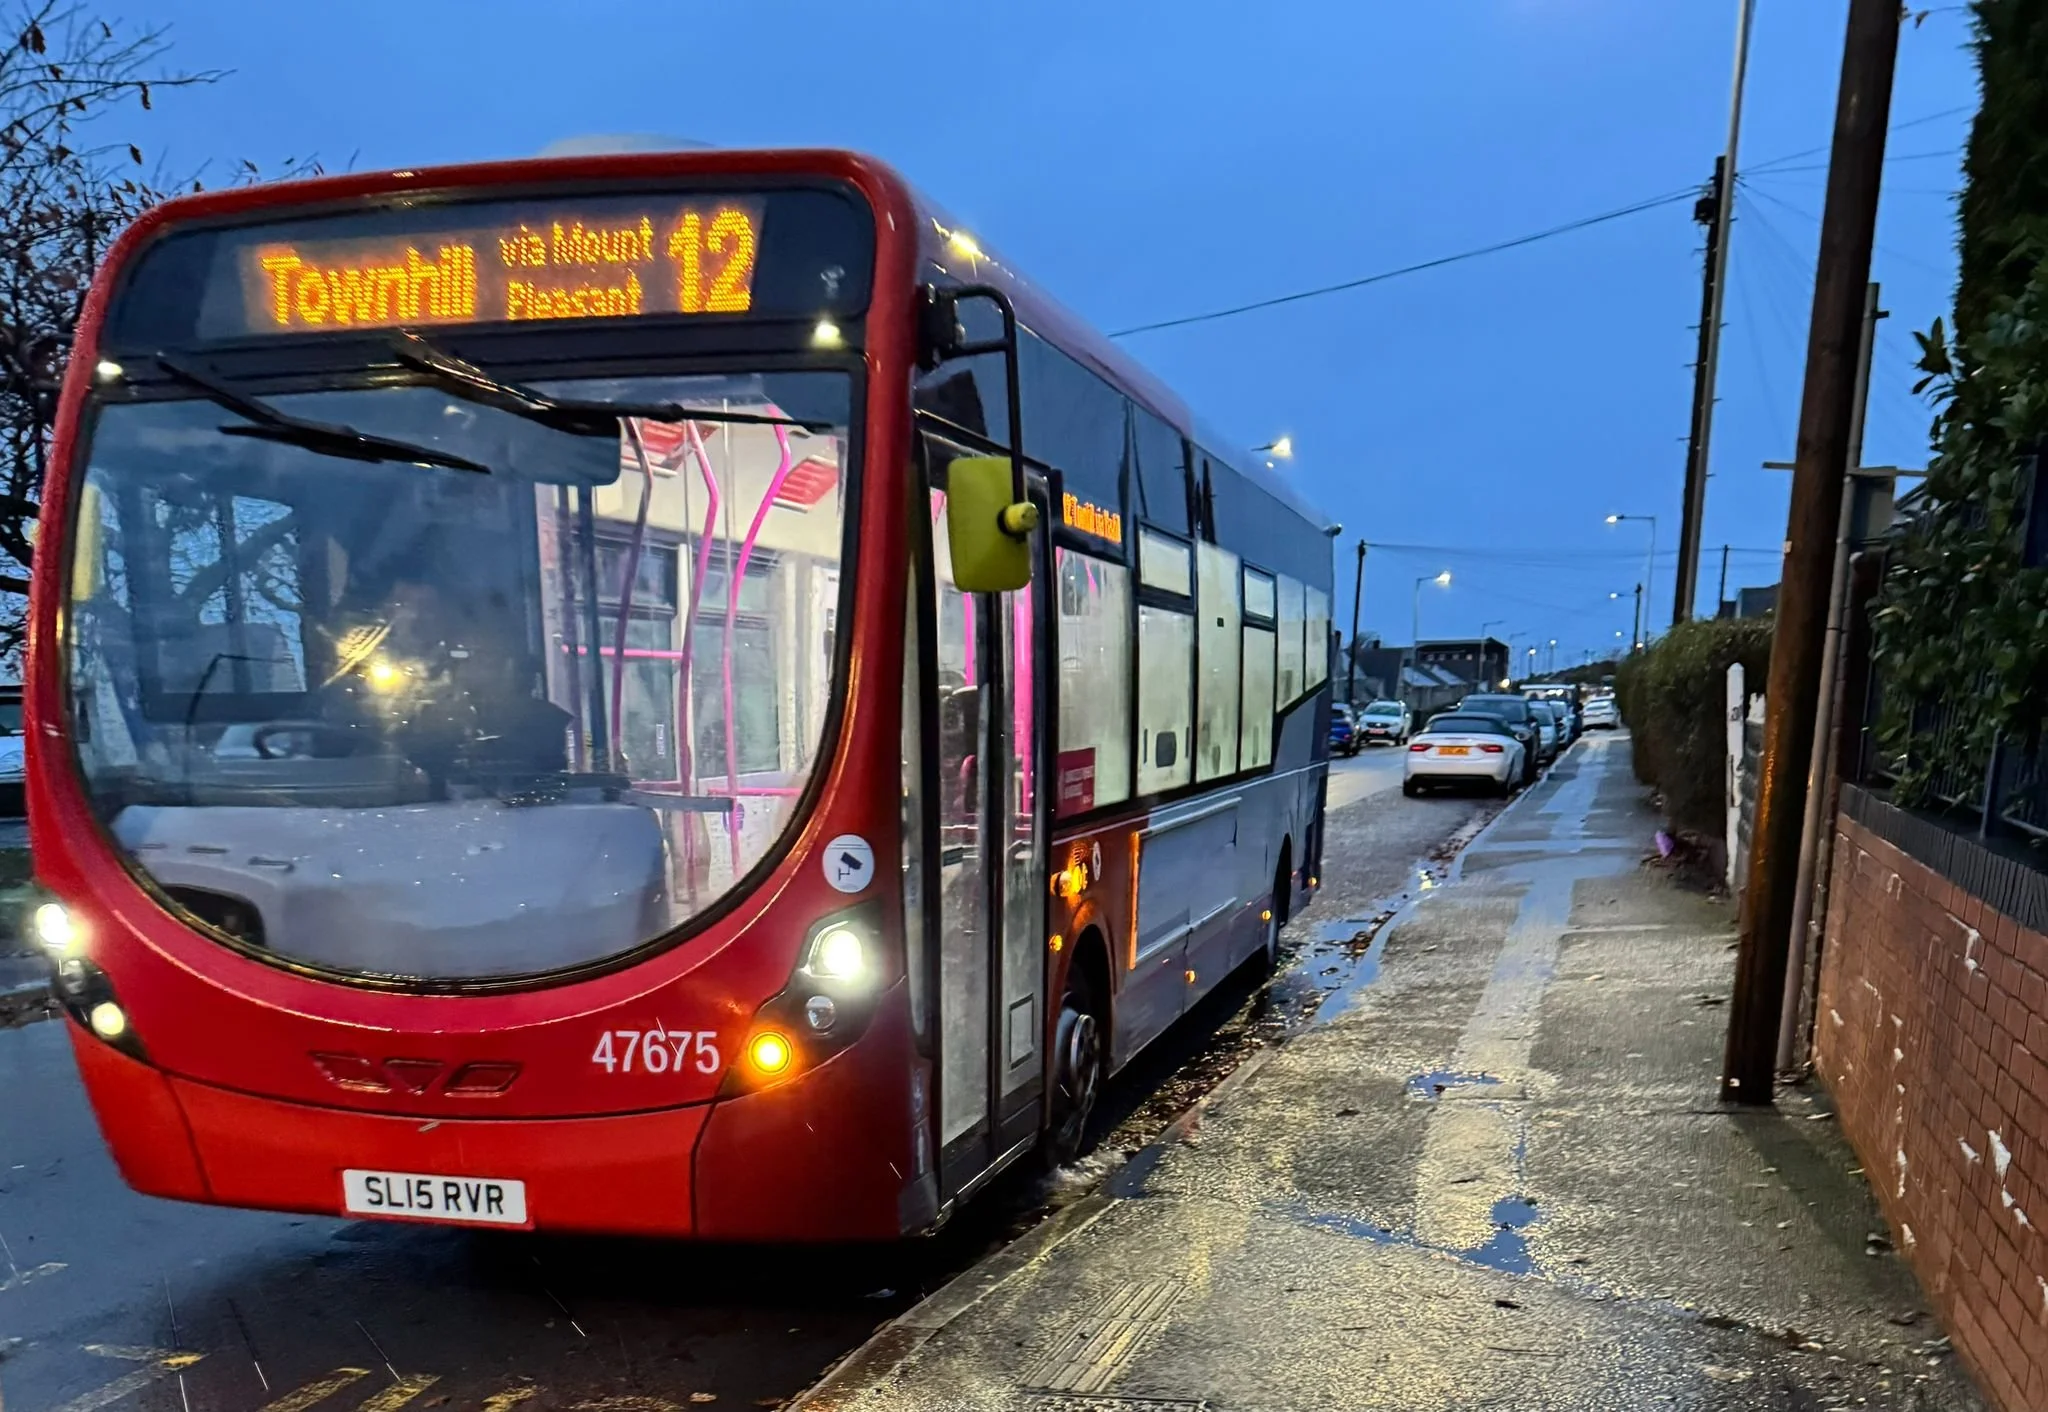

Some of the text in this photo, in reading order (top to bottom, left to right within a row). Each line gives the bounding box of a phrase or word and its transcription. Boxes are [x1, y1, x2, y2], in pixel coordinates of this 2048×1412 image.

[499, 216, 654, 267] via Mount
[667, 209, 754, 313] 12
[261, 245, 476, 325] Townhill
[507, 268, 643, 320] Pleasant
[591, 1030, 721, 1074] 47675
[364, 1176, 505, 1215] SL15 RVR
